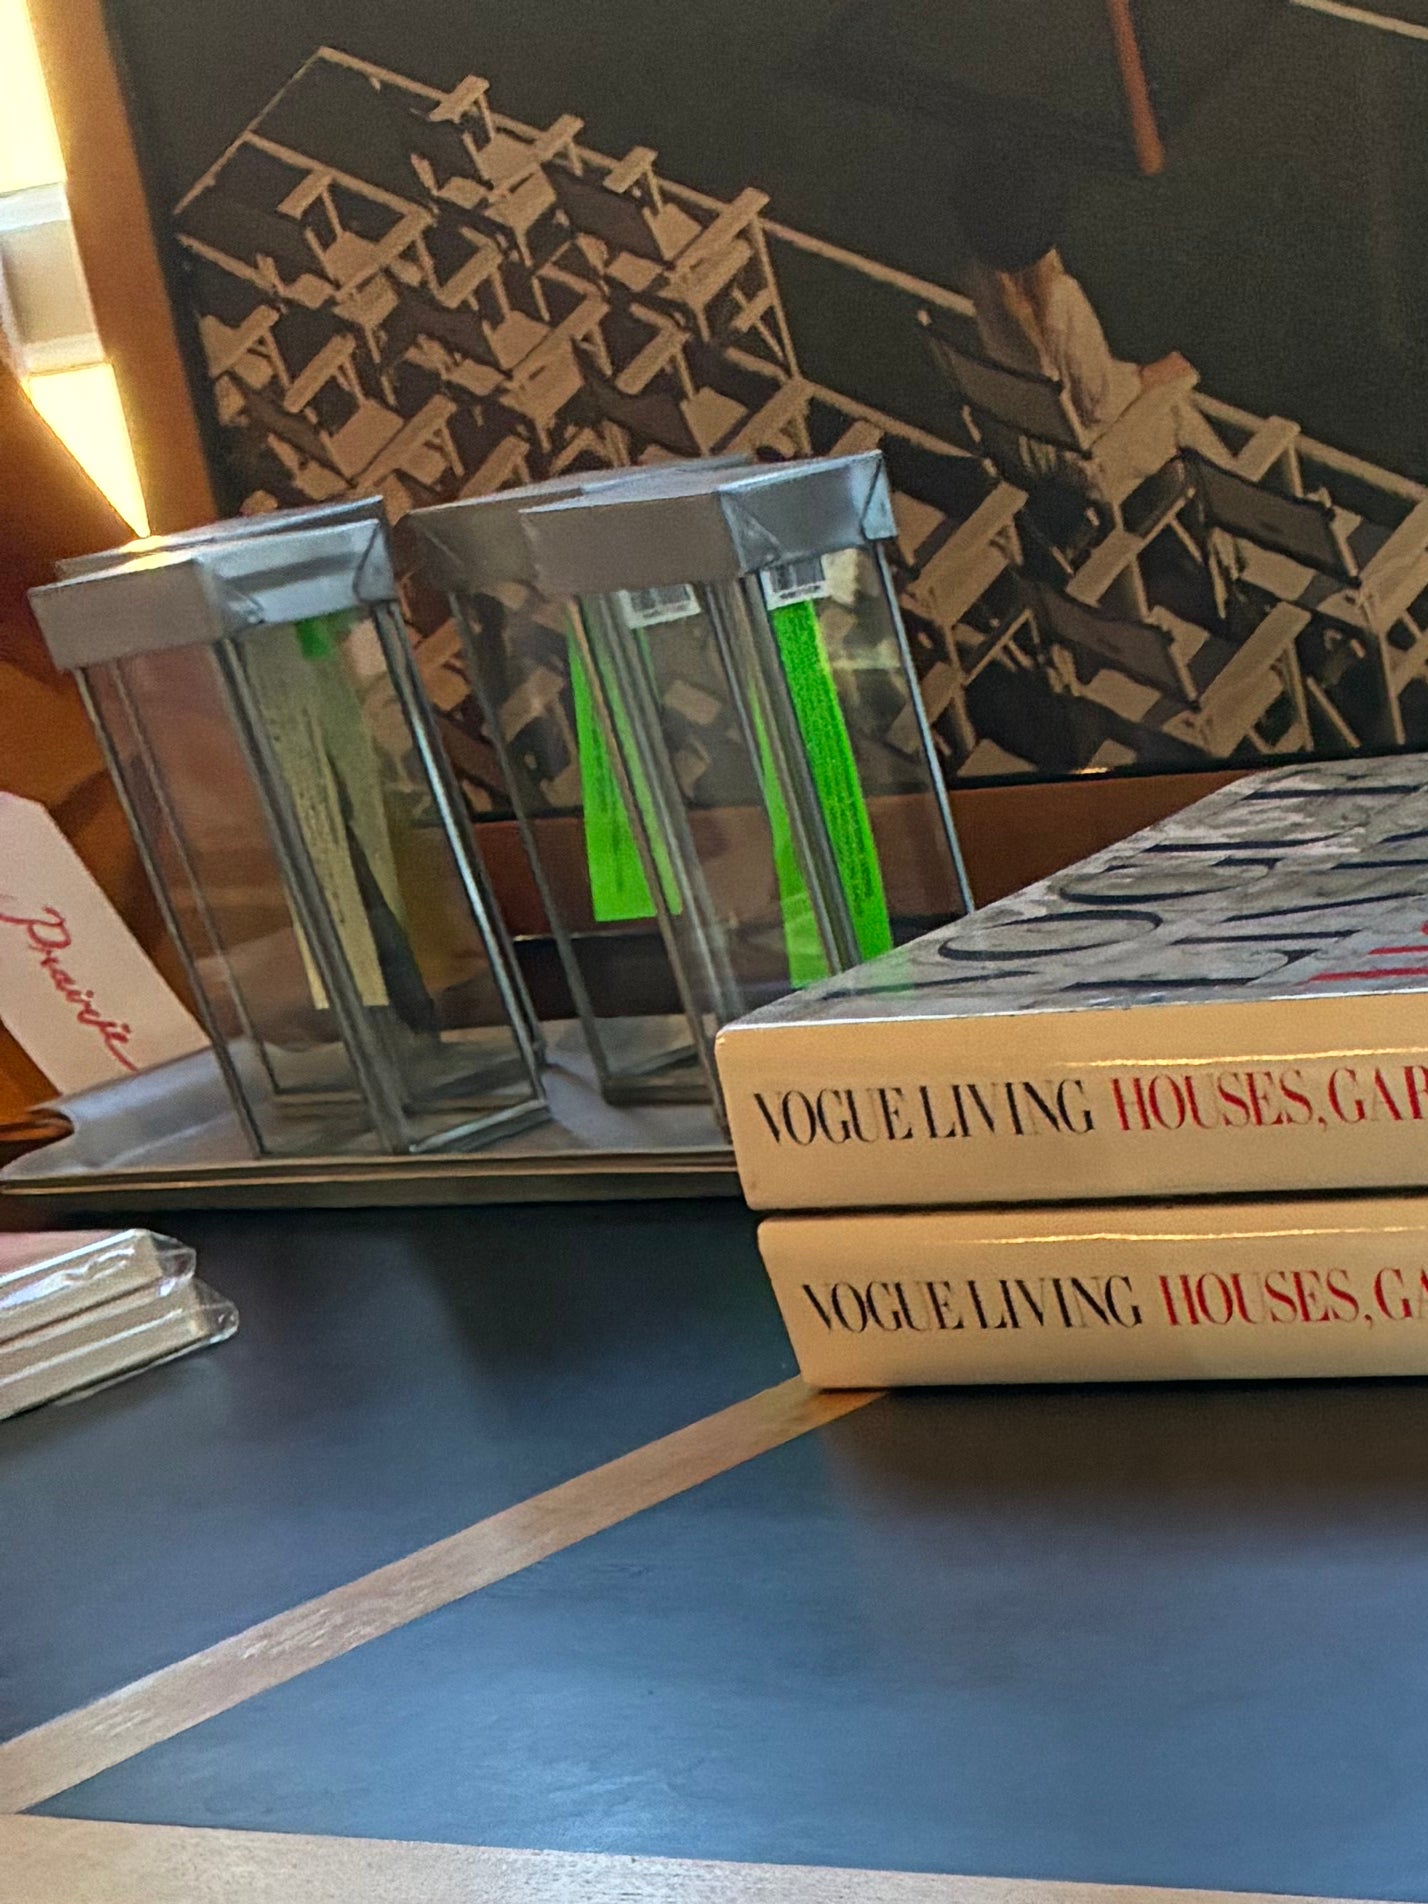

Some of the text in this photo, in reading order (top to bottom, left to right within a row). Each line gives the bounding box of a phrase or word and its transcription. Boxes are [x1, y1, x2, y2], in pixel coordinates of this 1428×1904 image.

[753, 1083, 913, 1146] VOGUE
[919, 1076, 1095, 1140] LIVING
[802, 1278, 965, 1334] VOGUE
[967, 1274, 1142, 1330] LIVING
